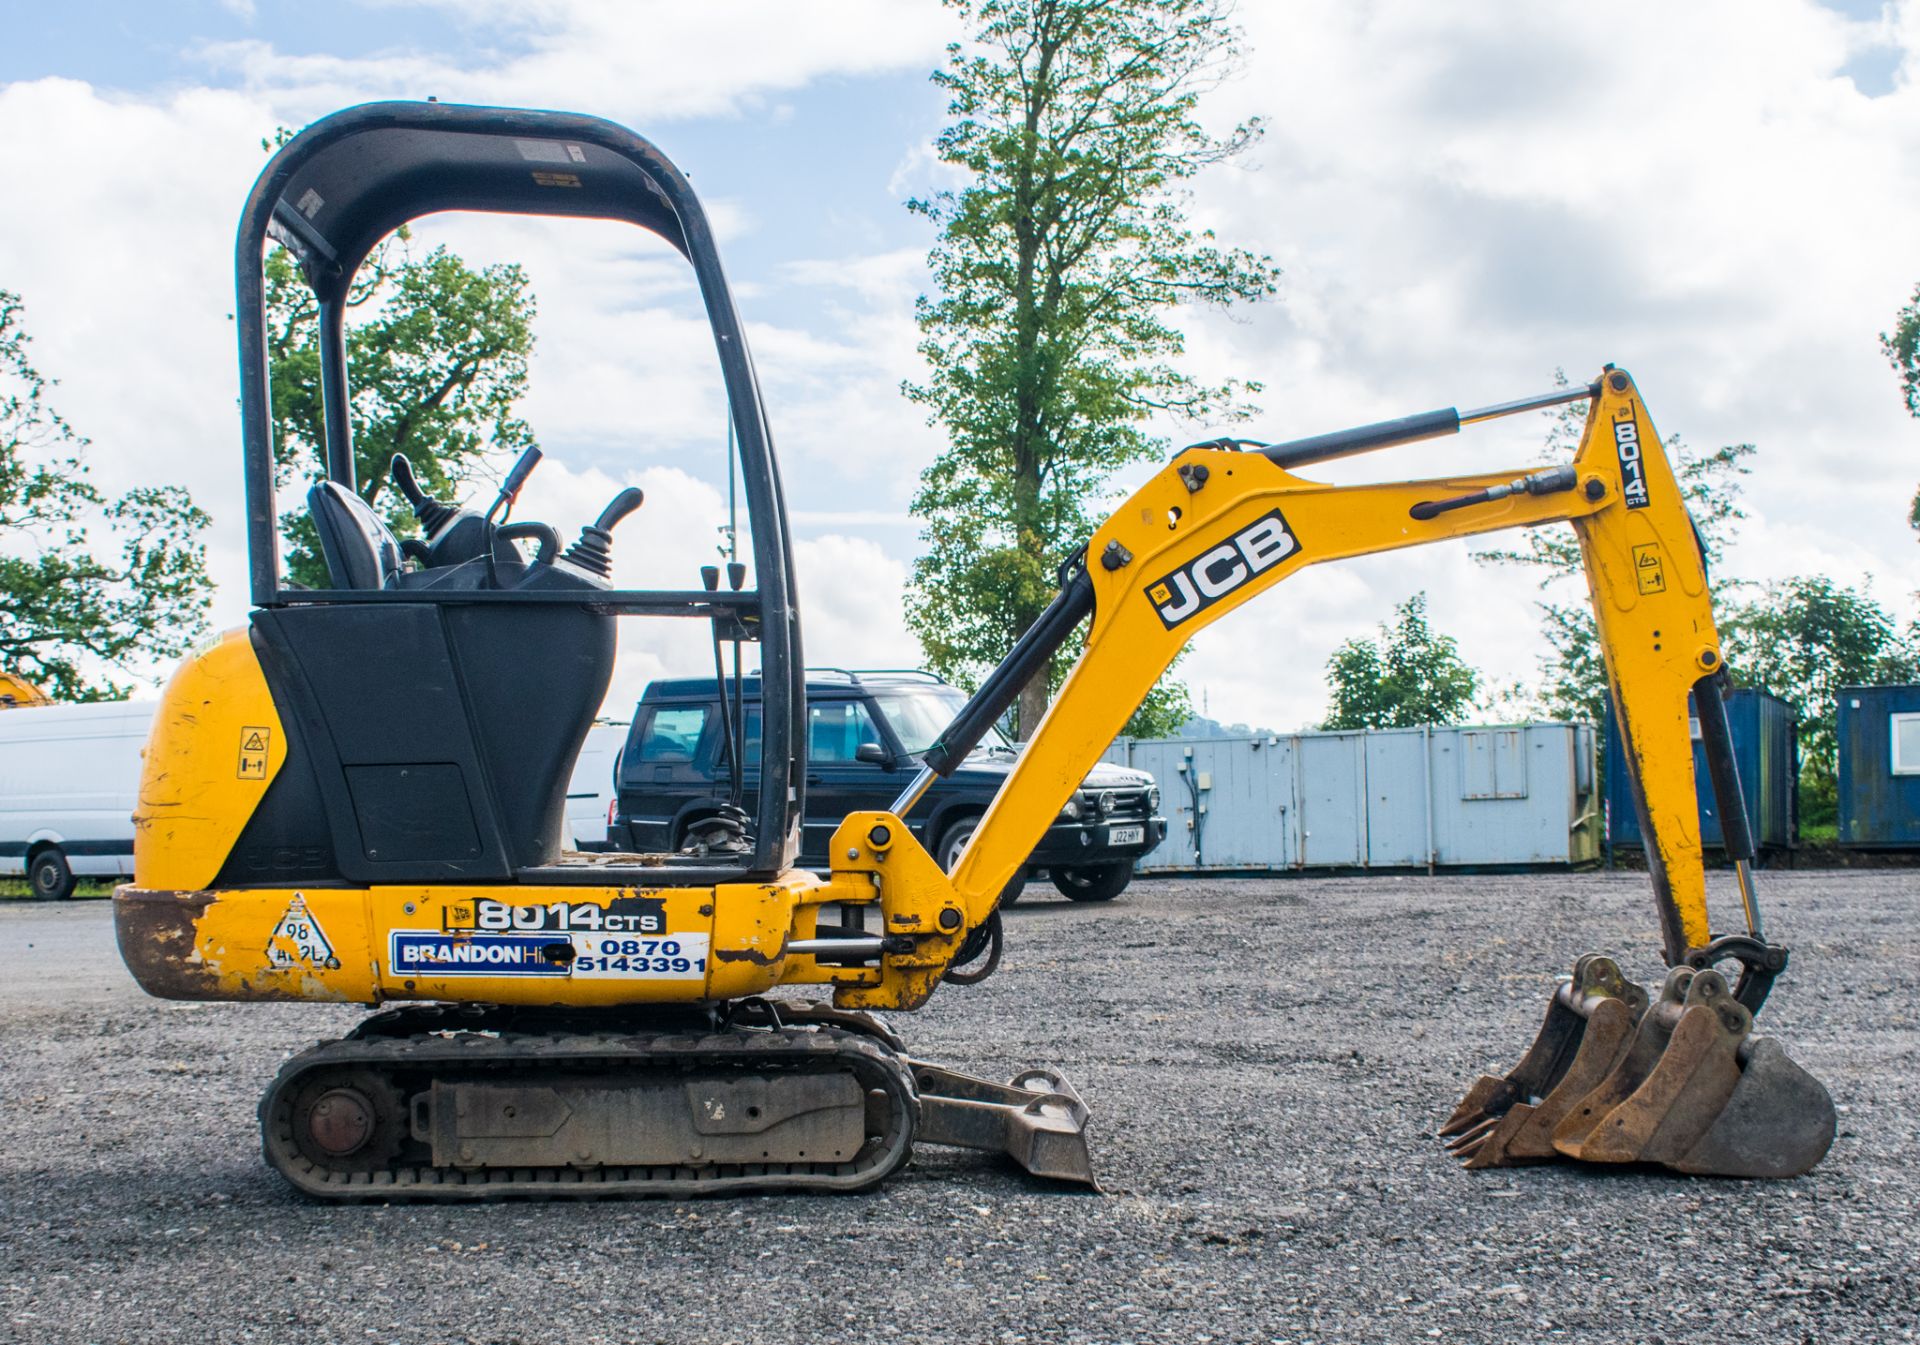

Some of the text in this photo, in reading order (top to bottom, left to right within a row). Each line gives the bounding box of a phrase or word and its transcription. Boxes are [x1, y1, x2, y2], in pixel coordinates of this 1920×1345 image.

[1615, 422, 1646, 497] 8014
[1626, 497, 1647, 505] CTS
[1160, 517, 1294, 623] JCB
[287, 923, 308, 940] 98
[600, 939, 682, 957] 0870
[576, 956, 706, 973] 5143391
